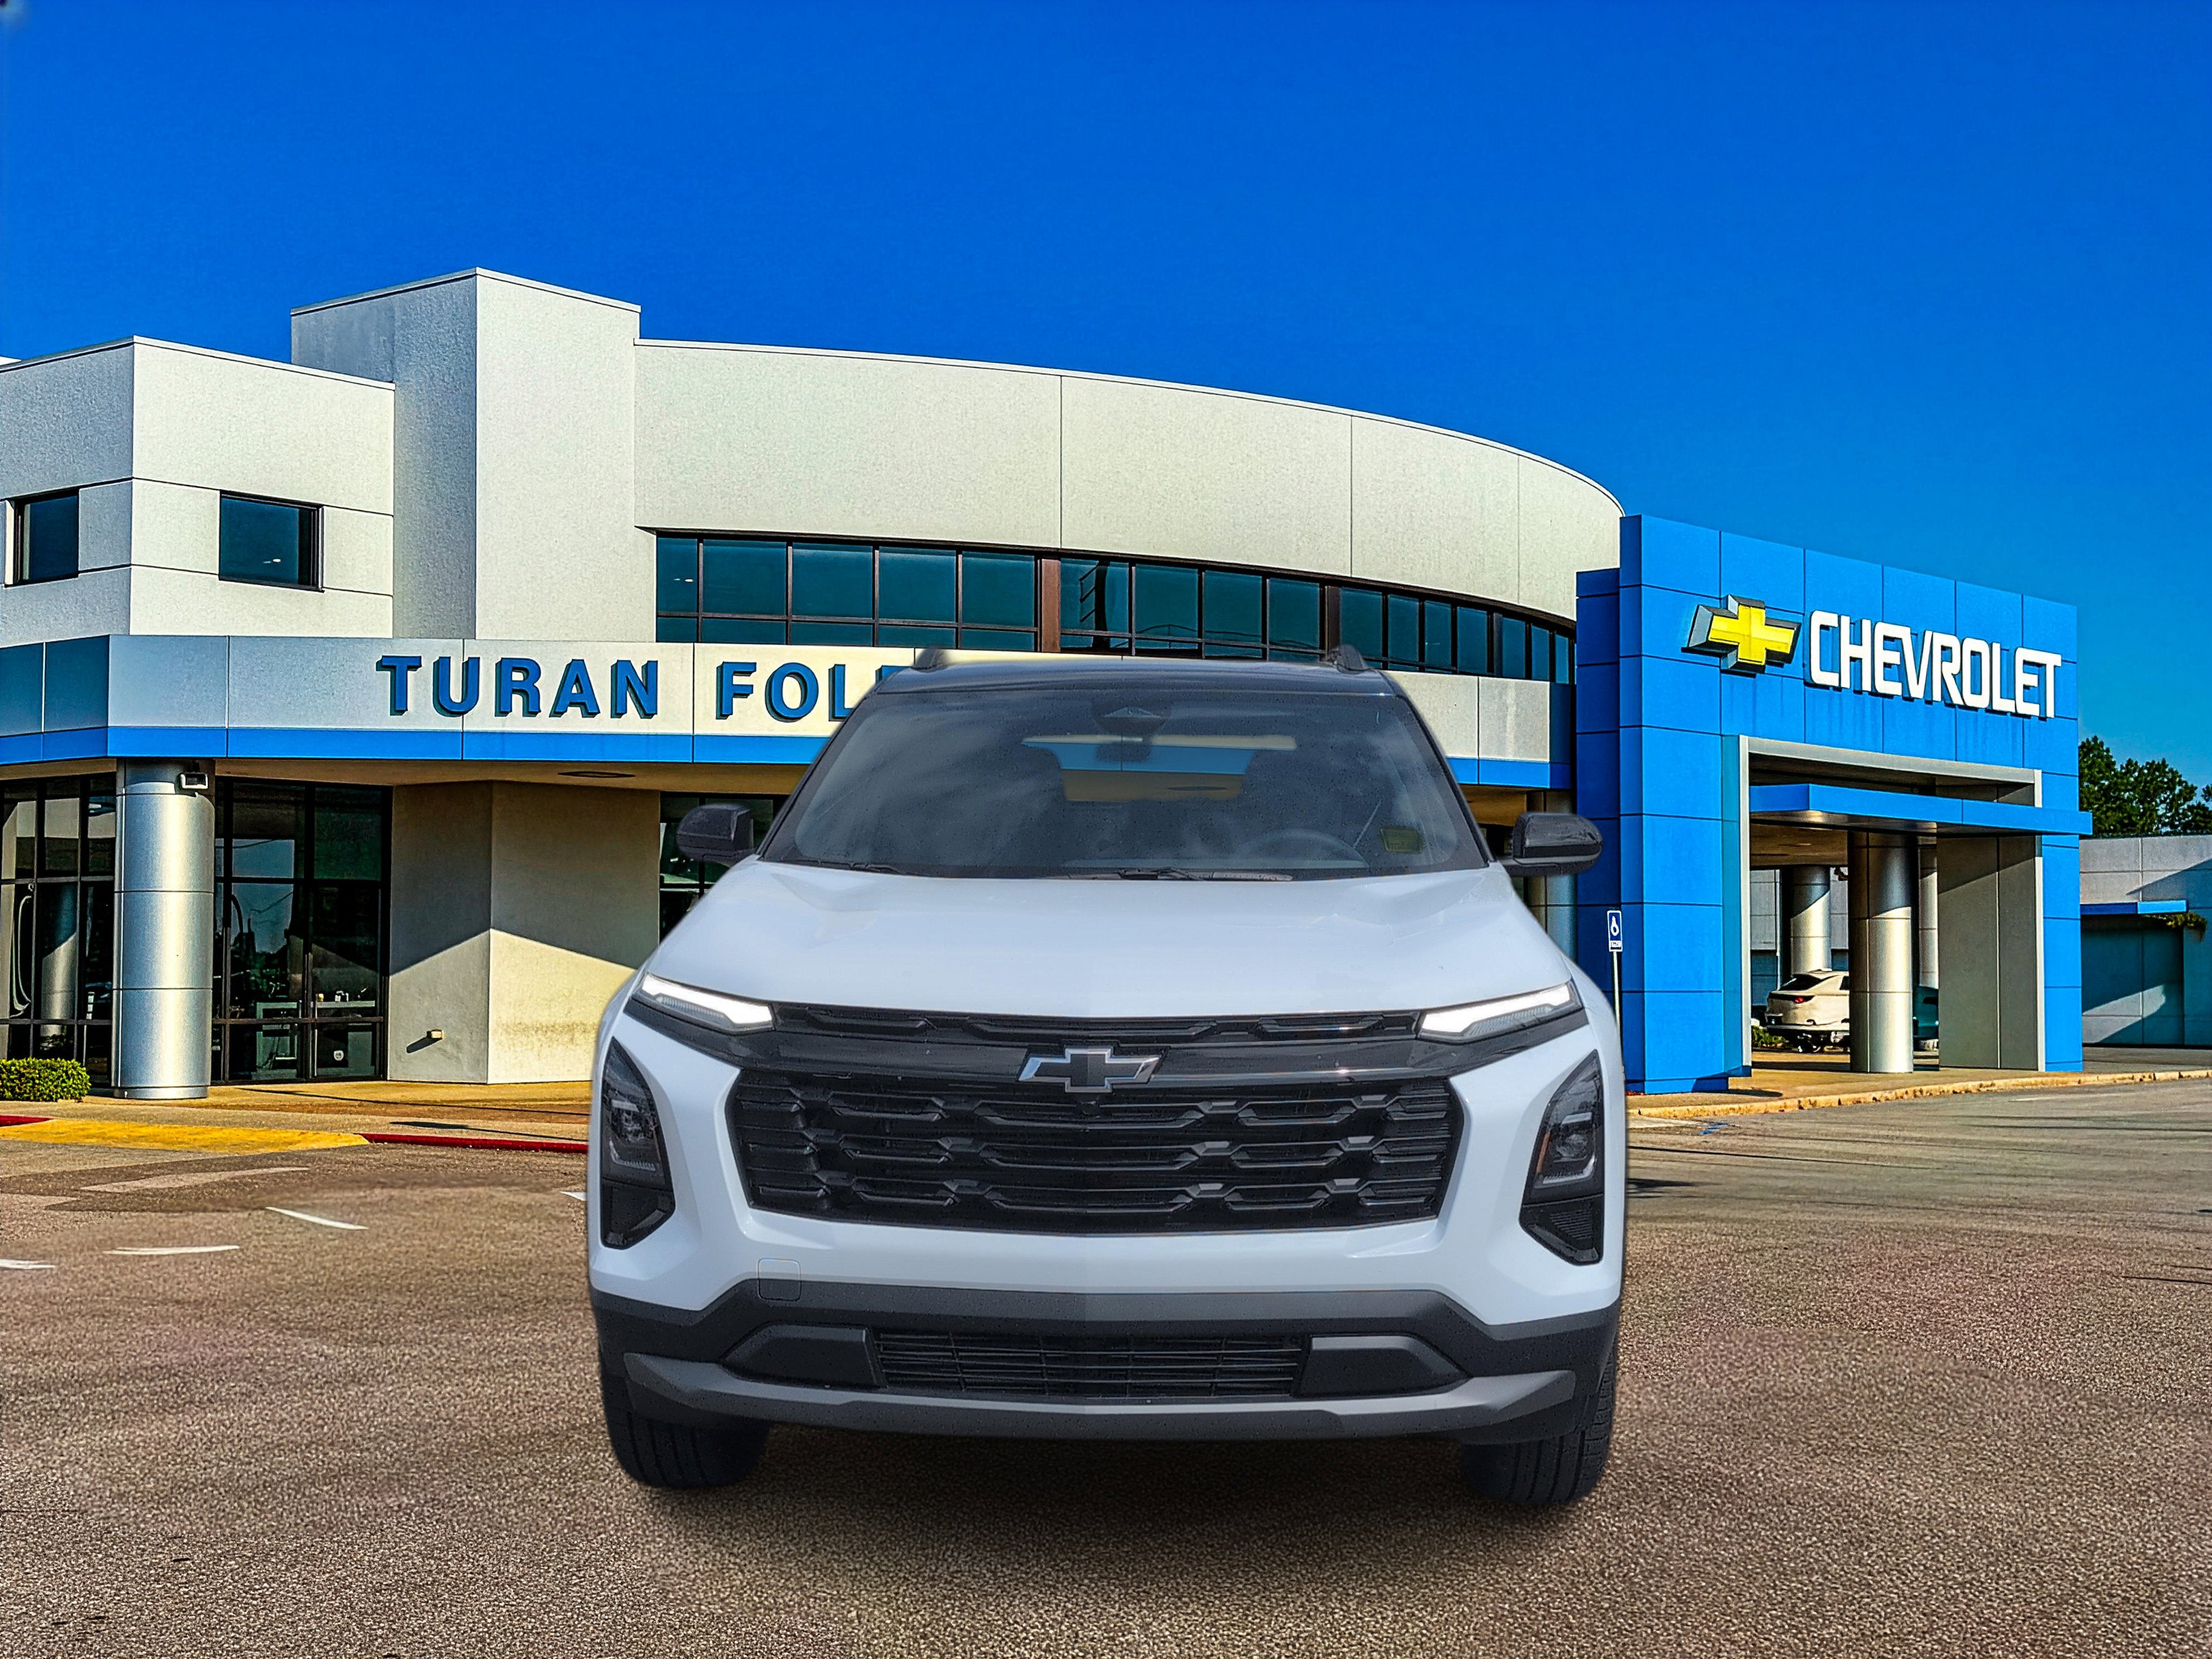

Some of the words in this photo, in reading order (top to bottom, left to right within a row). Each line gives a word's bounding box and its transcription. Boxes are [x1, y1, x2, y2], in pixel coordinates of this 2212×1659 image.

[376, 655, 659, 719] TURAN
[716, 661, 911, 723] FOL
[1809, 610, 2062, 718] CHEVROLET
